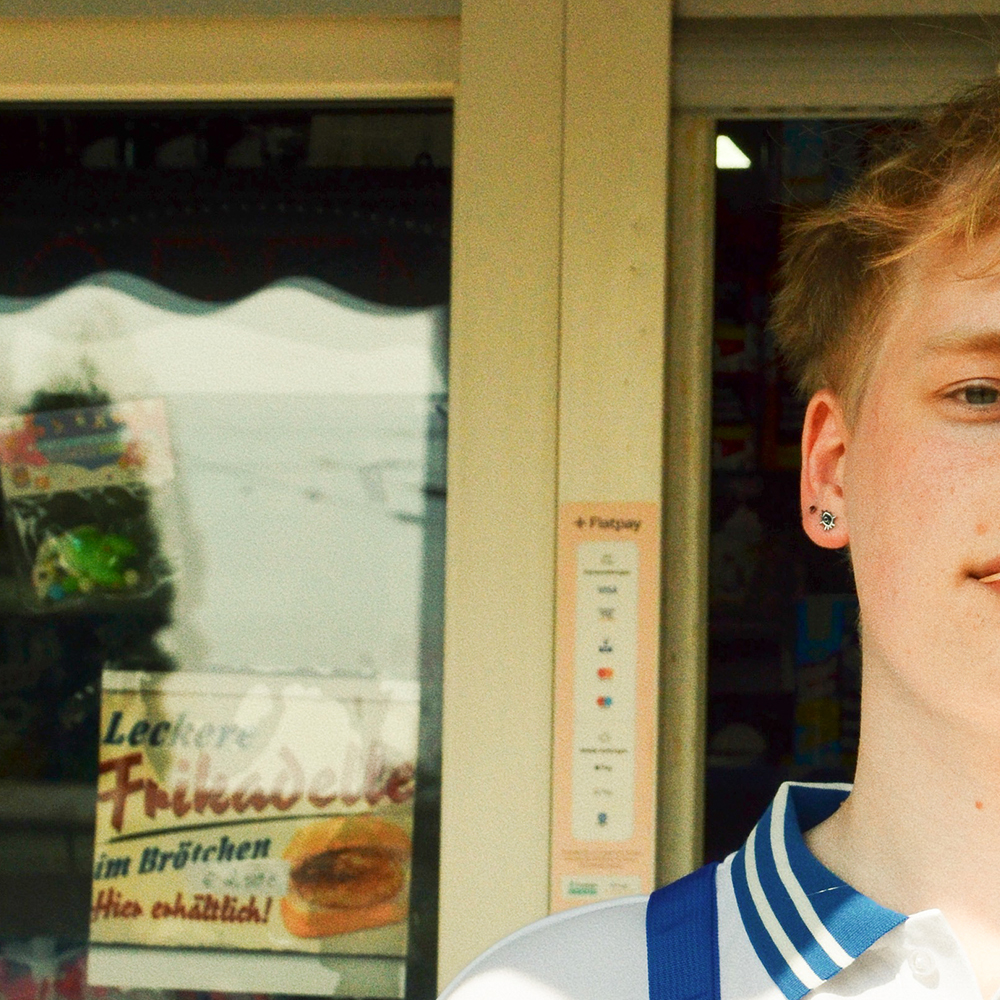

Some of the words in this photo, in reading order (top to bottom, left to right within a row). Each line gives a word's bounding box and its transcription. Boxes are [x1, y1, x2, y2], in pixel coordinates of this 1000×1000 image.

[104, 711, 258, 748] Leckere
[98, 743, 415, 832] Frikadelle
[94, 854, 131, 881] im
[138, 836, 272, 874] Brötchen
[93, 887, 142, 919] Hier
[152, 893, 272, 924] erhältlich!
